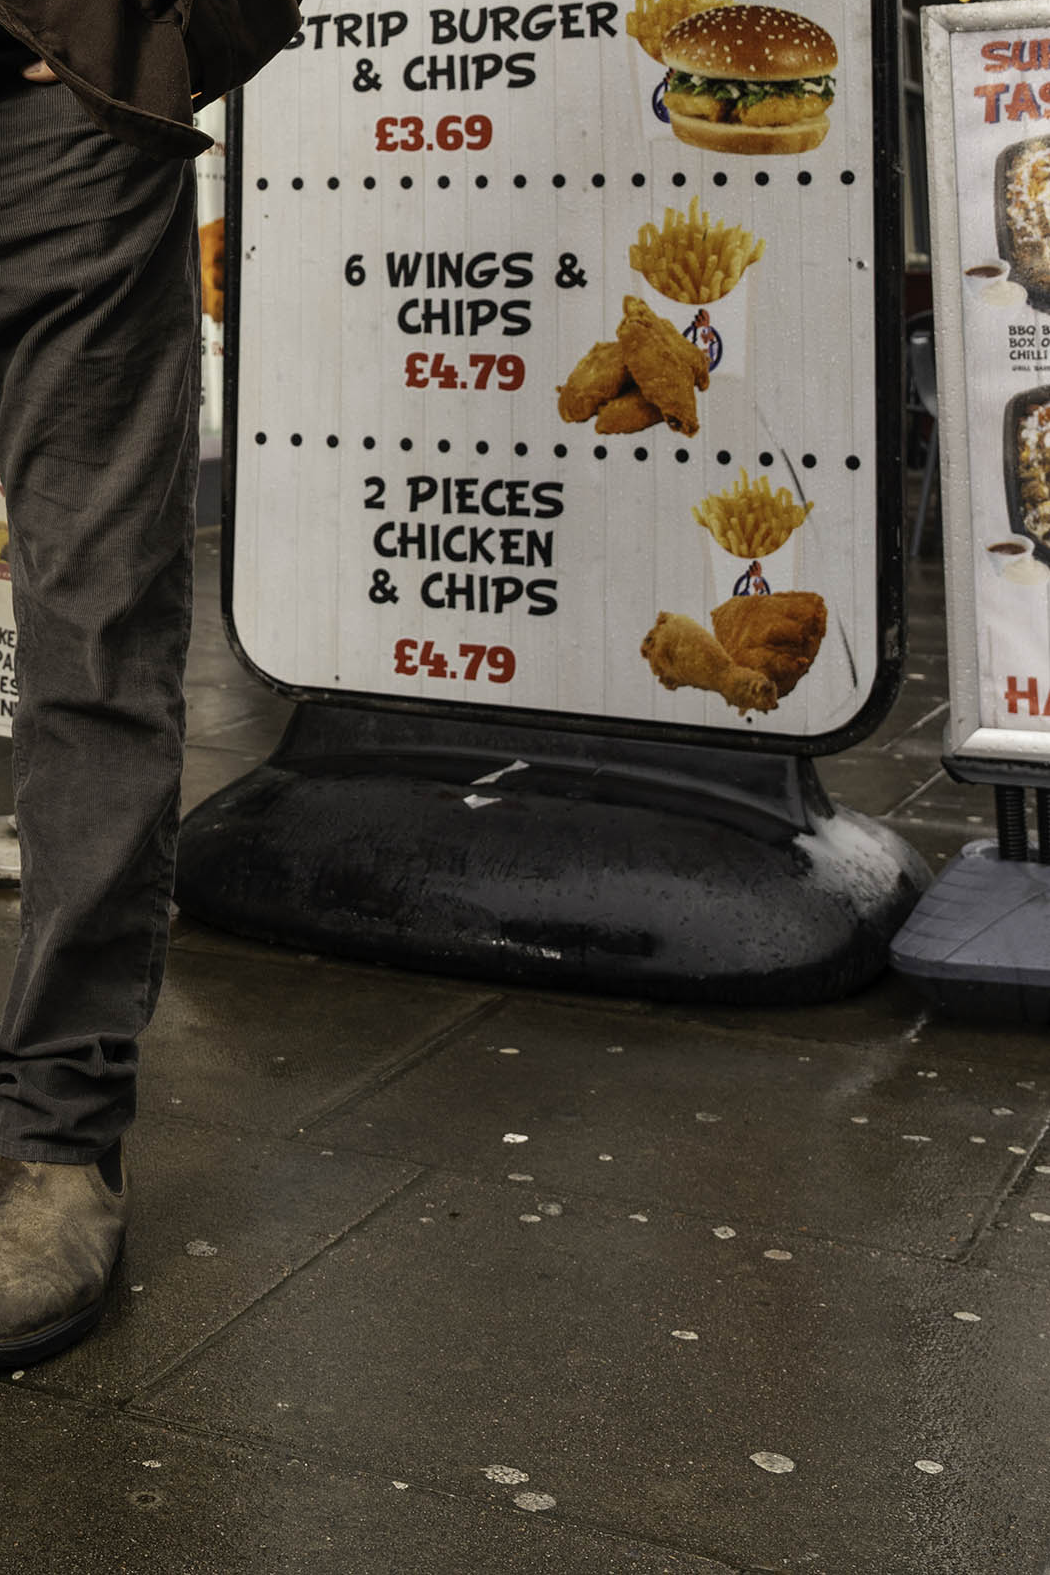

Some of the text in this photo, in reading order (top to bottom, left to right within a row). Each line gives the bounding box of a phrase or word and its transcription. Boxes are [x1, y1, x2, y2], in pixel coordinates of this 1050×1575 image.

[430, 1, 618, 45] BURGER
[353, 52, 537, 93] & CHIPS
[375, 114, 493, 153] £3.69
[345, 251, 588, 289] 6 WINGS &
[397, 298, 532, 337] CHIPS
[1009, 337, 1035, 348] BOX
[404, 351, 526, 392] £4.79
[363, 475, 565, 519] 2 PIECES
[373, 520, 554, 568] CHICKEN
[368, 568, 559, 617] & CHIPS
[393, 637, 517, 684] £4.79
